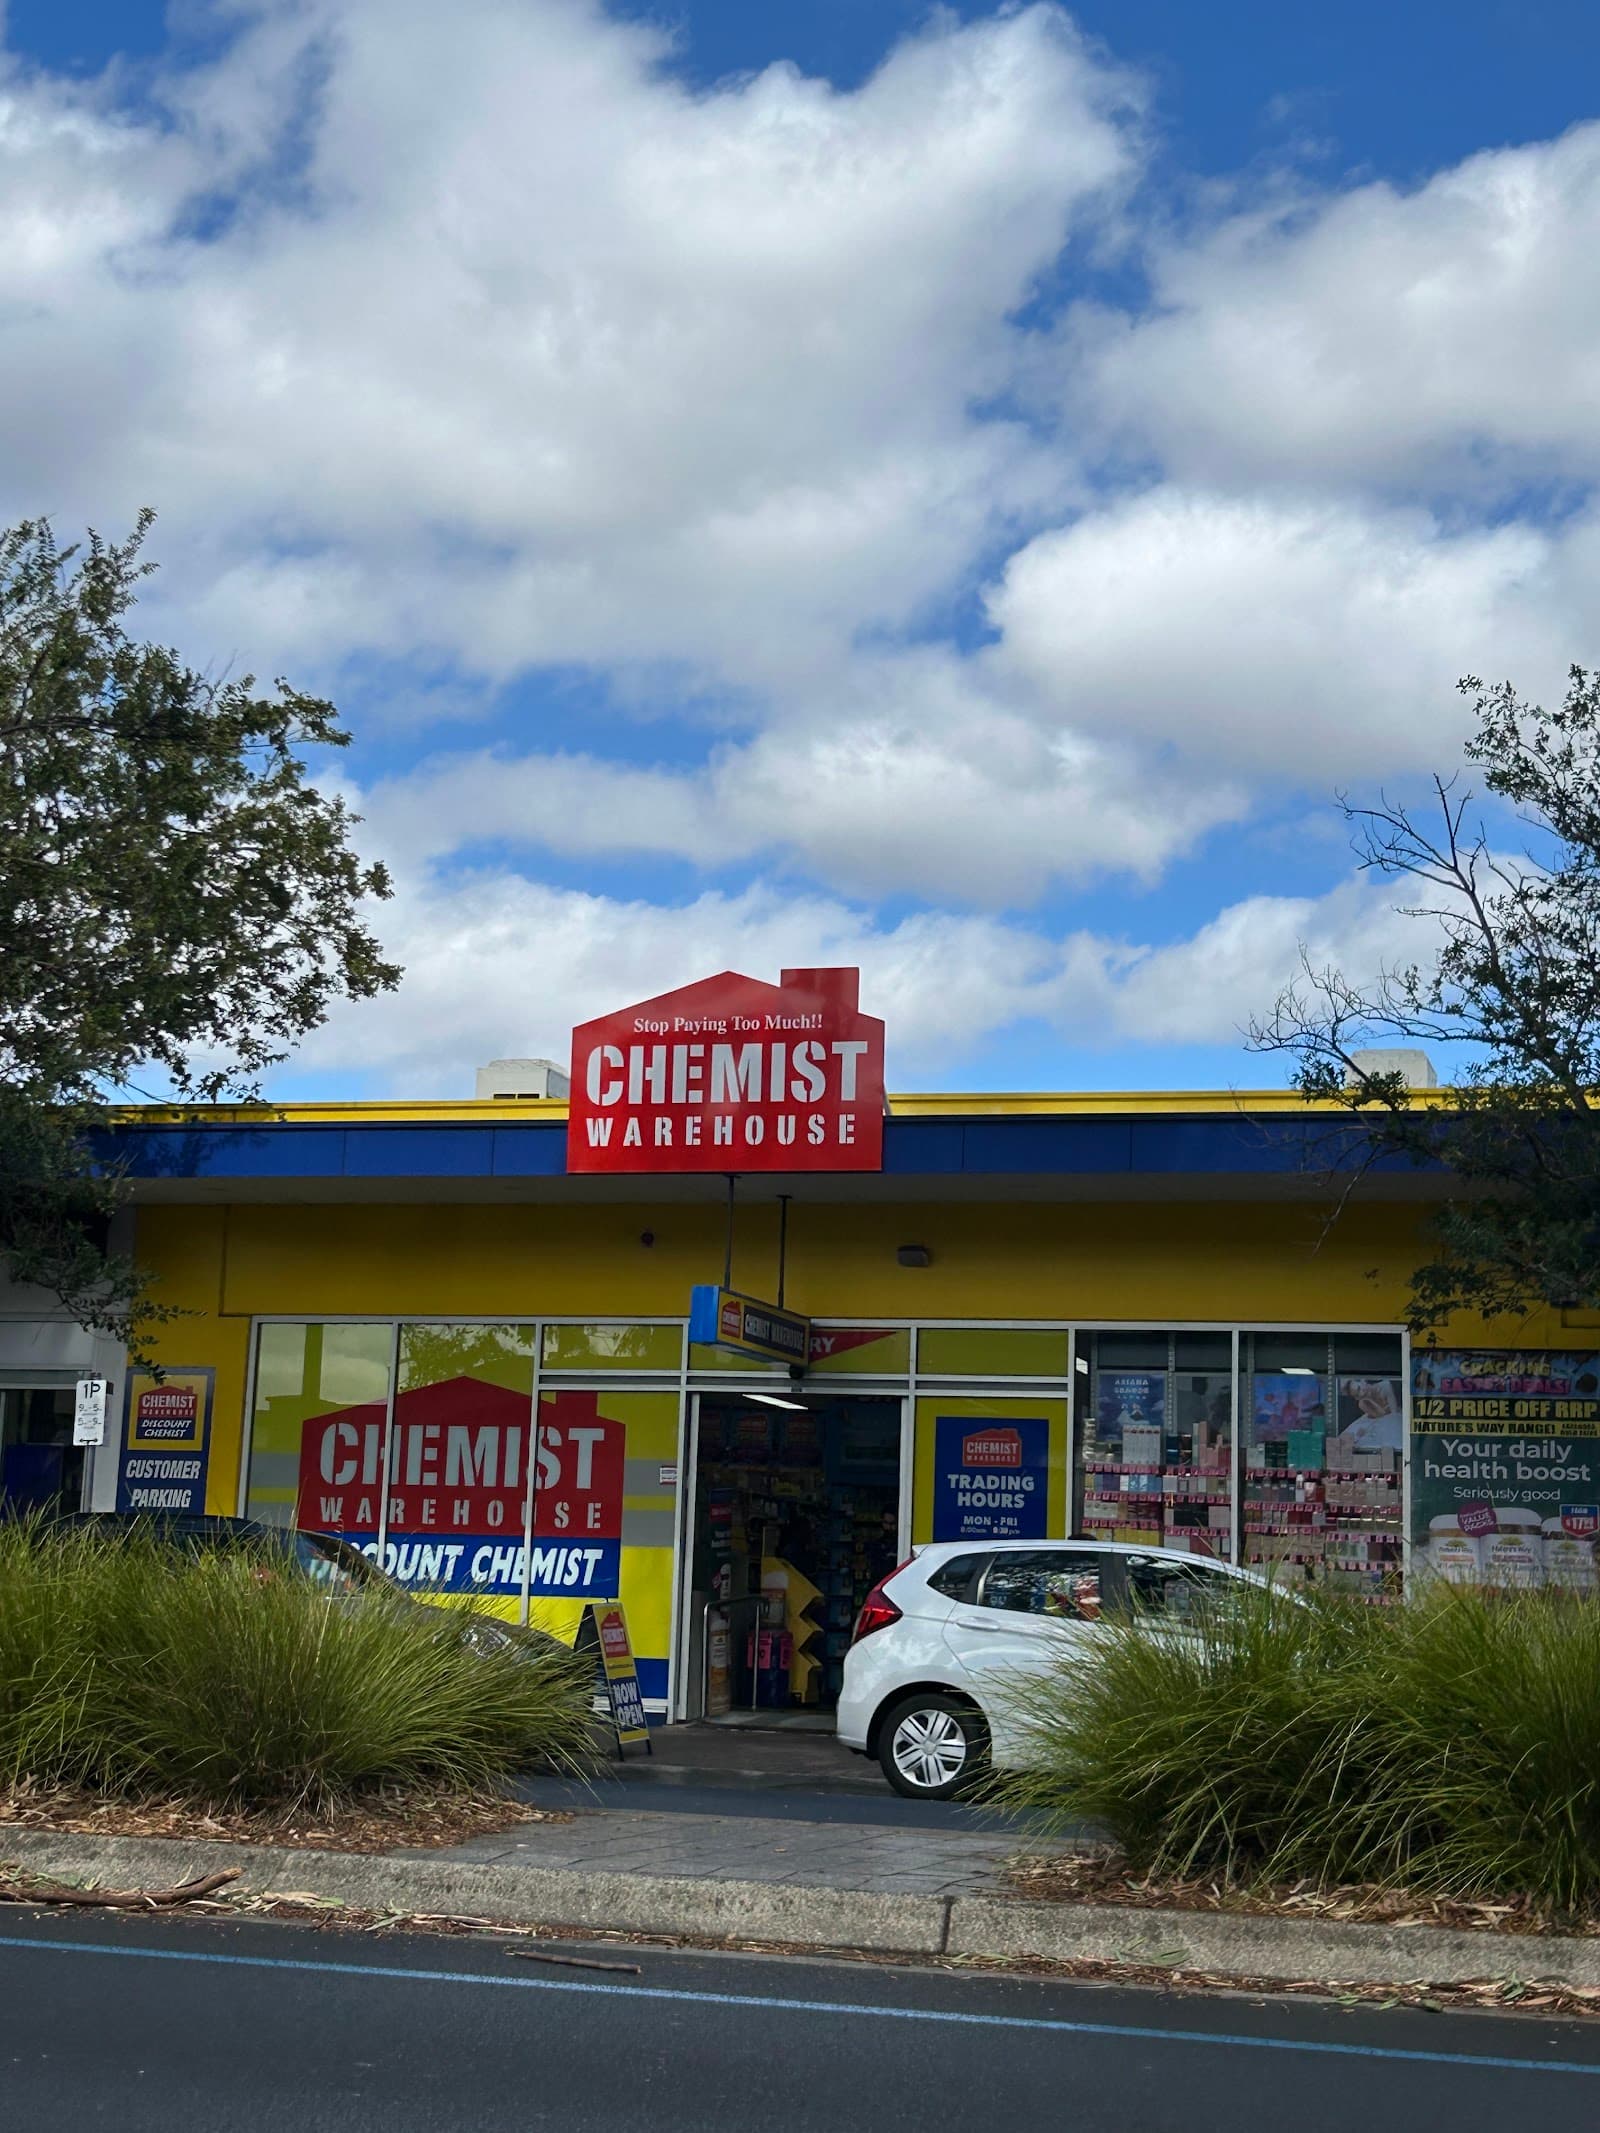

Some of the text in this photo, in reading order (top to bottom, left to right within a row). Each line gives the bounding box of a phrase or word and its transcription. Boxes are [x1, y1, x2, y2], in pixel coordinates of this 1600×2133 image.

[634, 1014, 822, 1036] Stop Paying Too Much!!
[586, 1040, 868, 1106] CHEMIST
[587, 1114, 855, 1147] WAREHOUSE
[1459, 1360, 1552, 1377] CRACKING
[84, 1382, 101, 1398] 1P
[142, 1395, 195, 1408] CHEMIST
[1417, 1400, 1597, 1418] 1/2 PRICE OFF RRP
[142, 1420, 192, 1428] DISCOUNT
[1414, 1421, 1474, 1433] NATURE'S
[1477, 1423, 1505, 1434] WAY
[1508, 1423, 1556, 1435] RANGE!
[144, 1429, 186, 1438] CHEMIST
[320, 1423, 605, 1490] CHEMIST
[966, 1441, 1018, 1455] CHEMIST
[1442, 1439, 1572, 1463] Your daily
[126, 1460, 201, 1480] CUSTOMER
[1424, 1460, 1591, 1481] health boost
[947, 1474, 1035, 1491] TRADING
[131, 1490, 192, 1509] PARKING
[957, 1492, 1025, 1509] HOURS
[1453, 1486, 1561, 1502] Seriously good
[963, 1516, 992, 1526] MON
[471, 1547, 602, 1586] CHEMIST
[613, 1683, 638, 1704] NOW
[618, 1704, 644, 1725] OPEN
